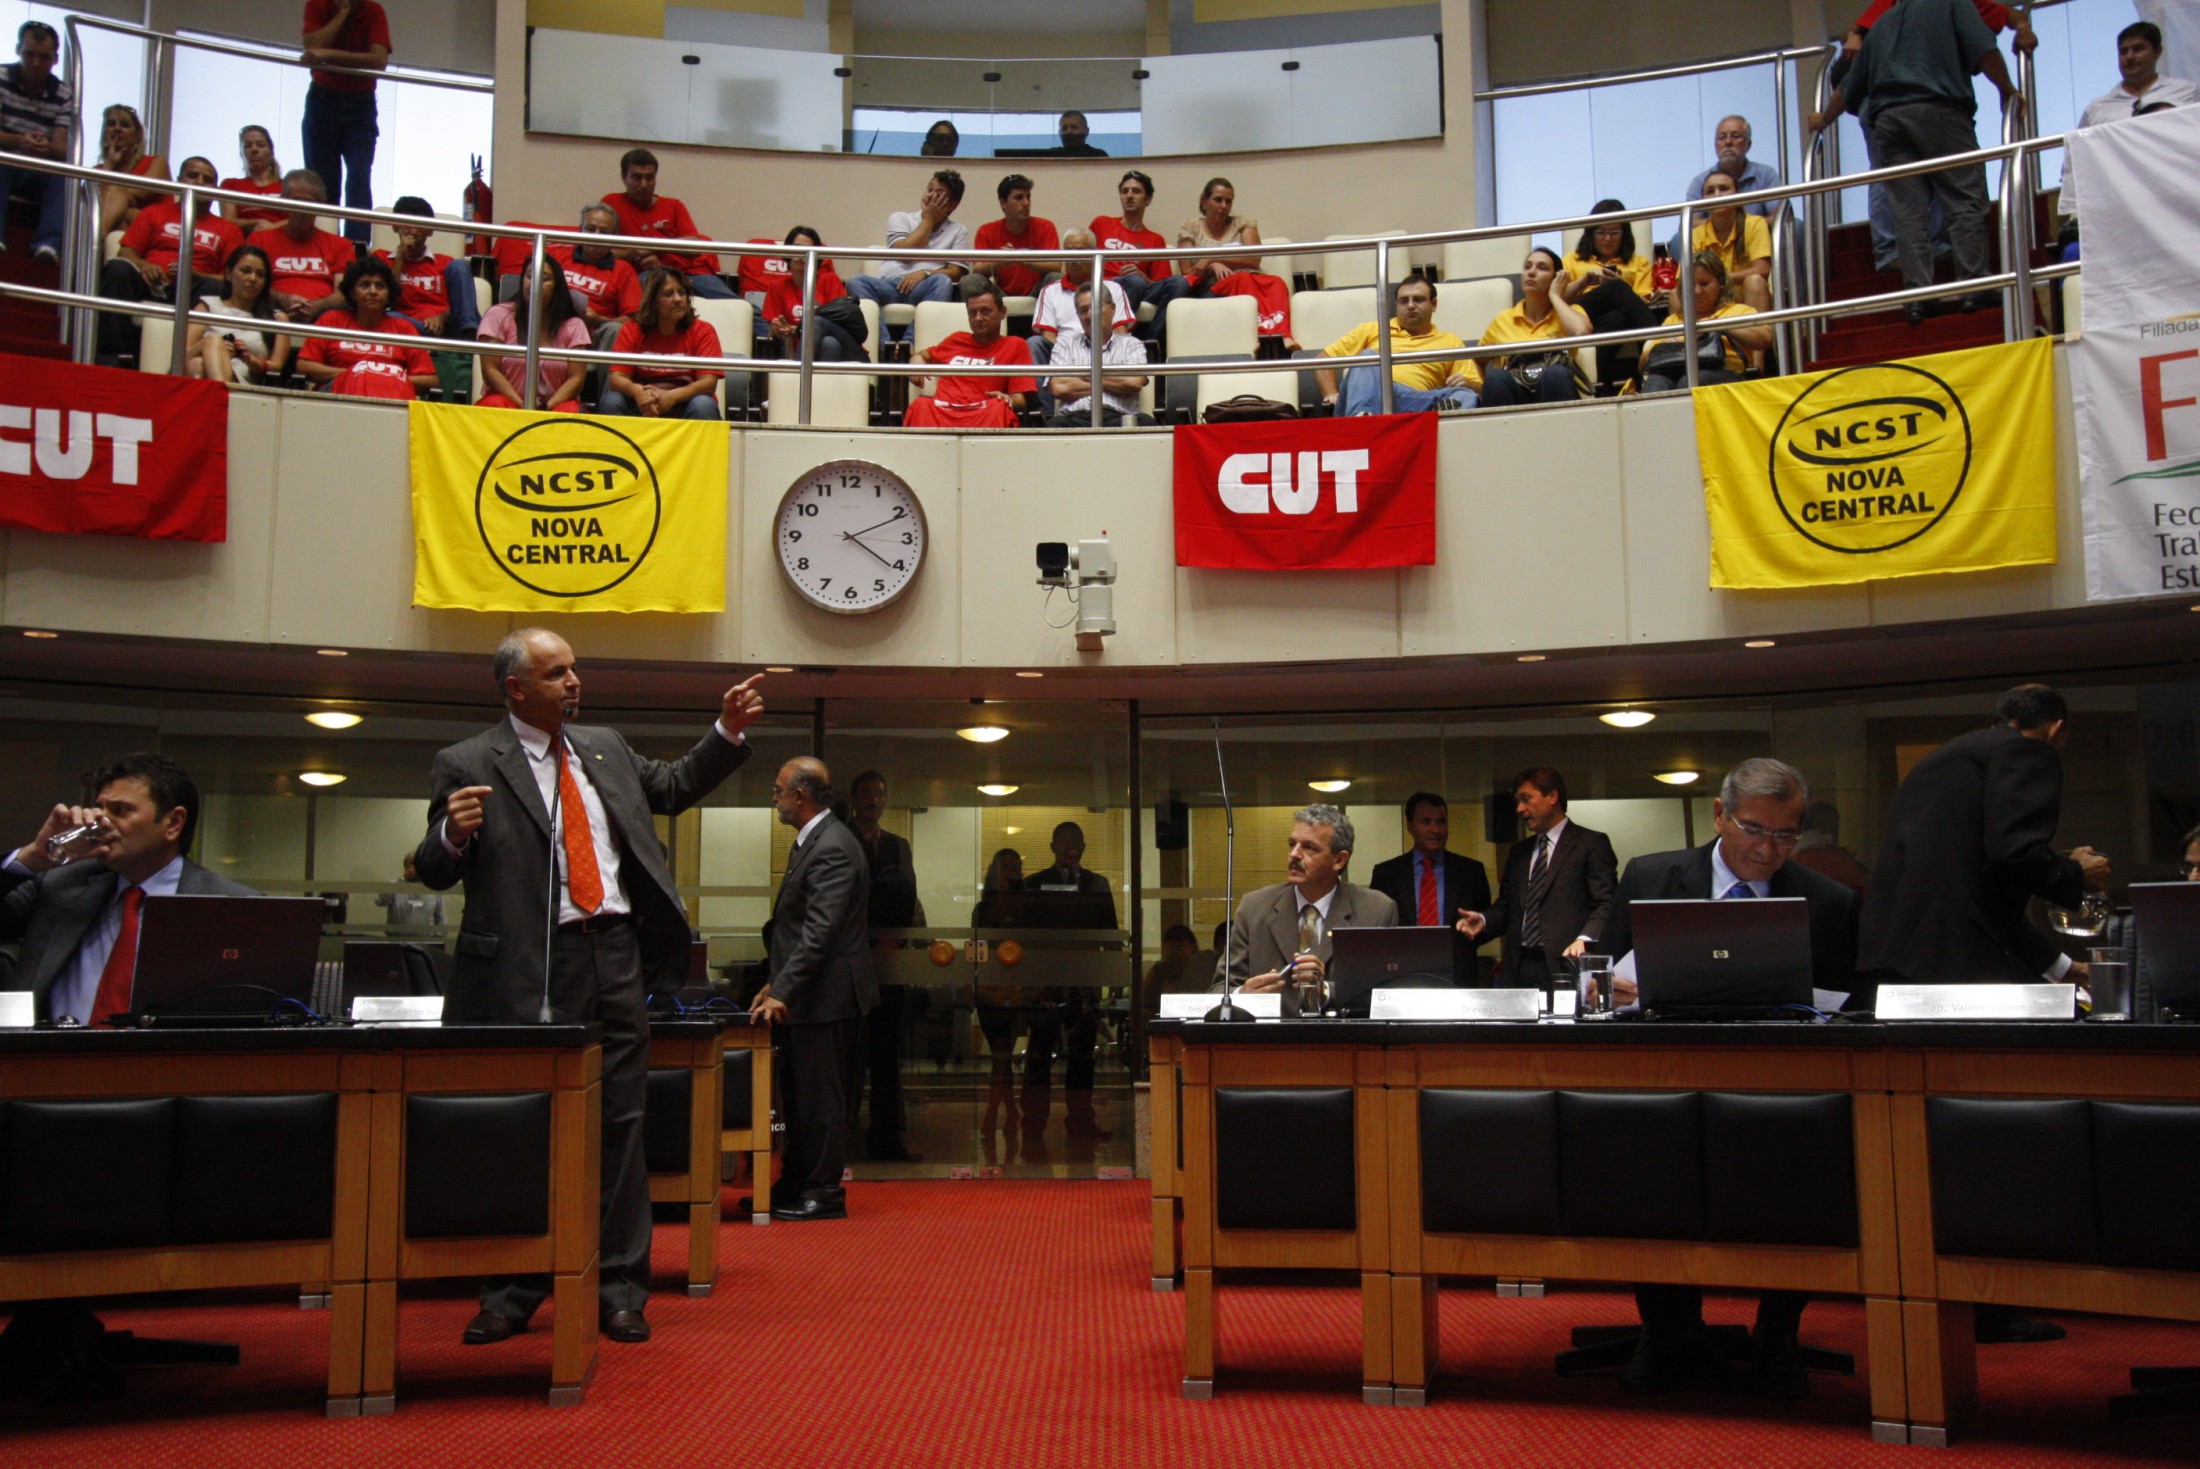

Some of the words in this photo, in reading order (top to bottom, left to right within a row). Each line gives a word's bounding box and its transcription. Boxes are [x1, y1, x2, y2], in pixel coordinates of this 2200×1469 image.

[164, 222, 214, 244] CT
[275, 257, 323, 270] CUT
[764, 259, 788, 273] CU
[2141, 320, 2199, 339] Filiada
[1815, 412, 1923, 451] NCST
[0, 404, 153, 486] CUT
[520, 469, 618, 496] NCST
[840, 475, 861, 488] 12
[1218, 448, 1370, 515] CUT
[1826, 466, 1906, 493] NOVA
[816, 484, 832, 497] 11
[874, 485, 882, 498] 1
[797, 503, 819, 517] 10
[892, 506, 905, 519] 2
[1801, 491, 1936, 524] CENTRAL
[531, 517, 604, 538] NOVA
[788, 530, 802, 543] 9
[901, 532, 913, 545] 3
[2154, 531, 2200, 557] Tra
[507, 543, 631, 565] CENTRAL
[797, 557, 810, 570] 8
[892, 559, 905, 572] 4
[819, 577, 832, 590] 7
[873, 579, 885, 592] 5
[844, 586, 858, 599] 6
